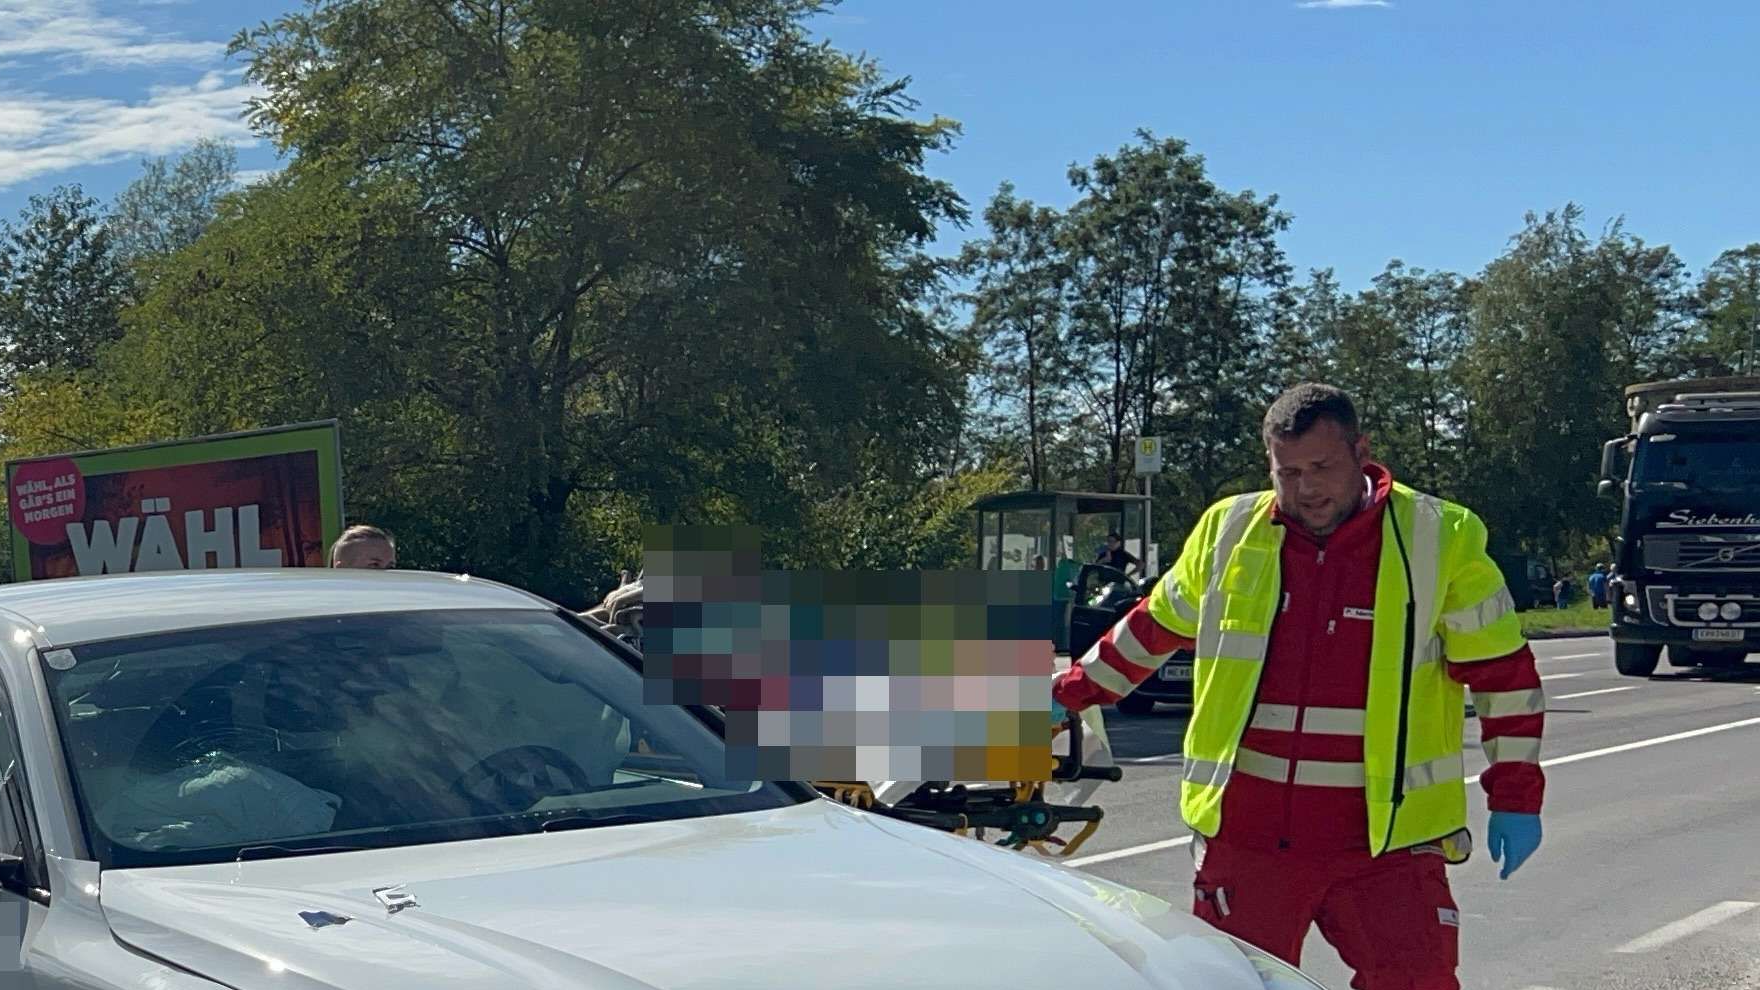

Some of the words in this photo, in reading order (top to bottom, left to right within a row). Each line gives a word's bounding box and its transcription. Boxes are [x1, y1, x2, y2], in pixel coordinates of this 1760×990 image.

[54, 473, 76, 489] ALS
[56, 488, 76, 503] EIN
[24, 503, 74, 524] MORGEN
[65, 497, 282, 576] WÄHL
